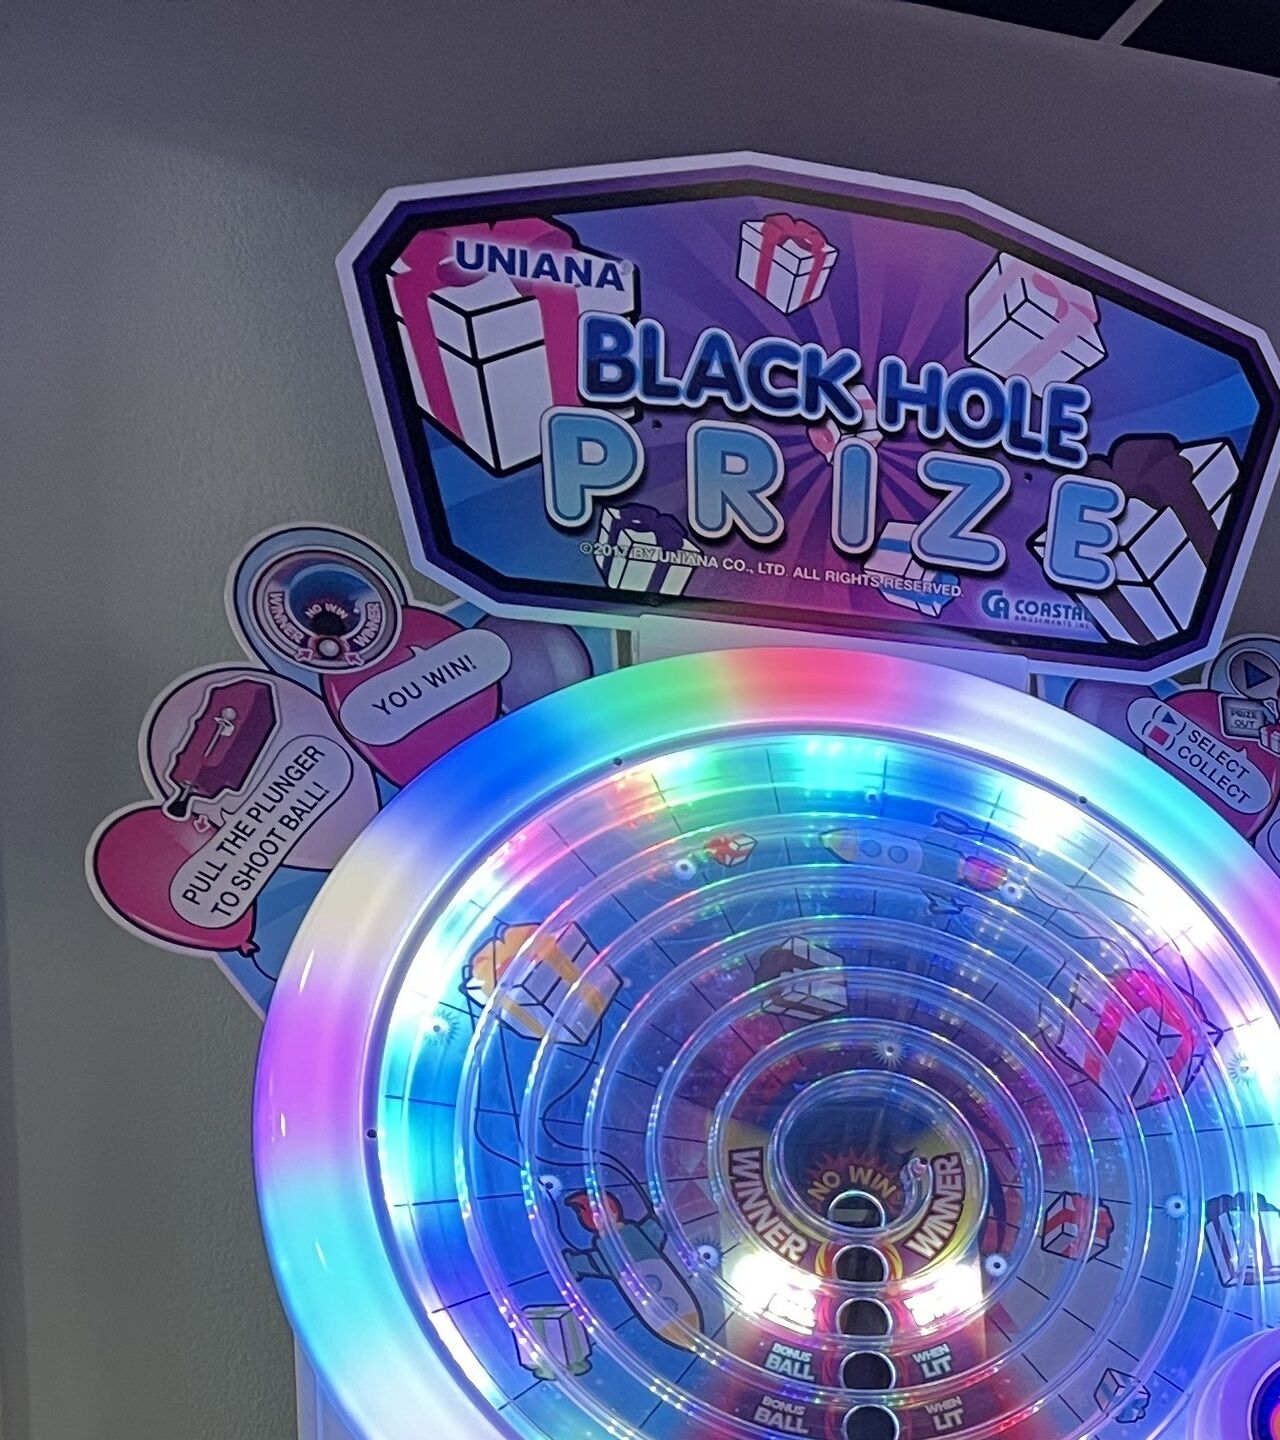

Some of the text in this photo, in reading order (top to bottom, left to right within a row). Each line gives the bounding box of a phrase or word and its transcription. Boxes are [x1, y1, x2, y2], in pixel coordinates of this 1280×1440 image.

[454, 239, 625, 293] UNIANA
[579, 314, 1091, 468] BLACK HOLE
[542, 407, 1125, 591] PRIZE
[630, 545, 655, 562] BY
[659, 550, 719, 568] UNIANA
[758, 561, 789, 578] LTD.
[792, 566, 821, 581] ALL
[825, 569, 880, 589] RIGHTS
[882, 574, 964, 598] RESERVED.
[268, 591, 305, 644] WINNER
[305, 602, 349, 620] NO WIN
[352, 601, 381, 648] WINNER
[1015, 599, 1096, 622] COASTAL
[371, 654, 477, 718] YOU WIN!
[1176, 744, 1253, 806] COLLECT
[1186, 728, 1251, 781] SELECT
[181, 745, 327, 906] PULL THE PLUNGER
[210, 780, 332, 918] TO SHOOT BALL!
[728, 1146, 810, 1262] WINNER
[807, 1163, 898, 1201] NO WIN
[904, 1151, 967, 1260] WINNER
[763, 1353, 816, 1382] BALL
[772, 1342, 813, 1363] BONUS
[912, 1343, 951, 1364] WHEN
[919, 1356, 953, 1380] LIT
[753, 1406, 809, 1435] BALL
[760, 1395, 806, 1418] BONUS
[924, 1395, 962, 1417] WHEN
[932, 1408, 964, 1432] LIT
